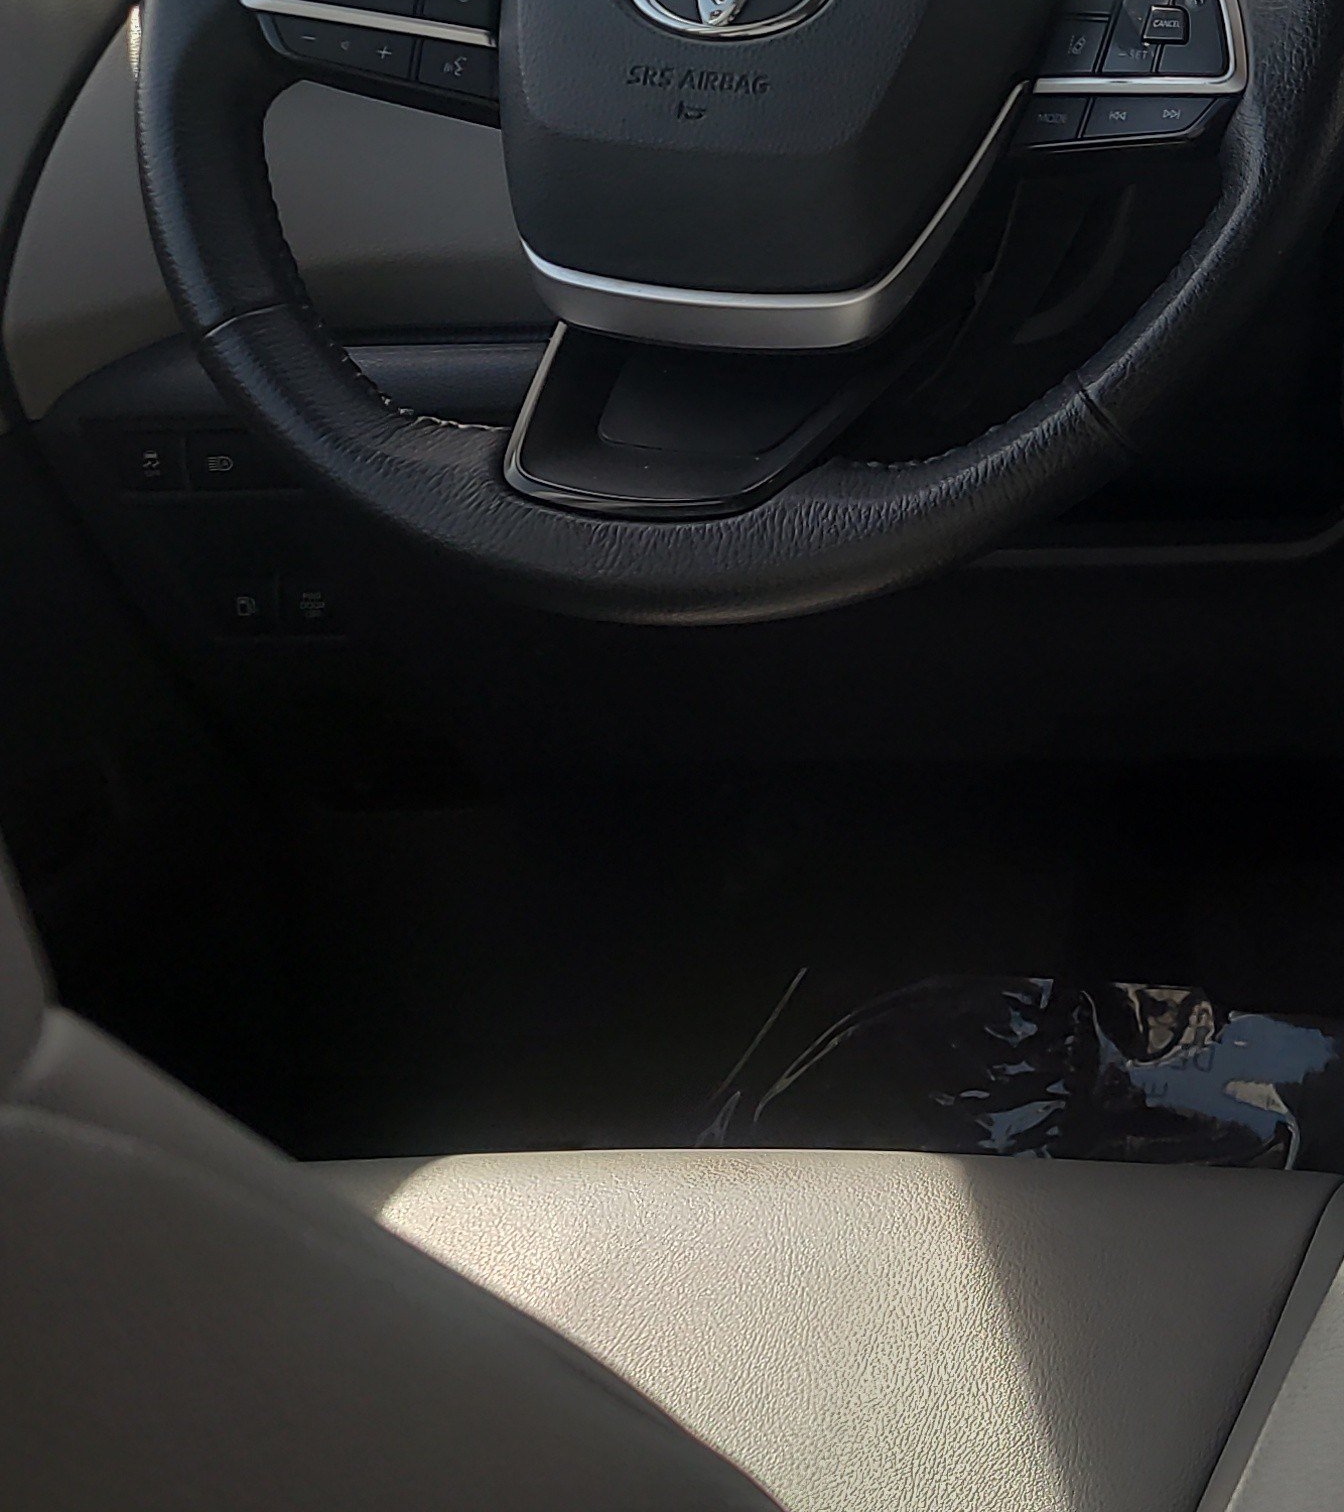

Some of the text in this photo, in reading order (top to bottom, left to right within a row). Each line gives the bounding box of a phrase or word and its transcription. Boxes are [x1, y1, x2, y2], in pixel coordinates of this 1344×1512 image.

[1153, 19, 1180, 28] CANCEL
[627, 65, 771, 95] SRS AIRBAG
